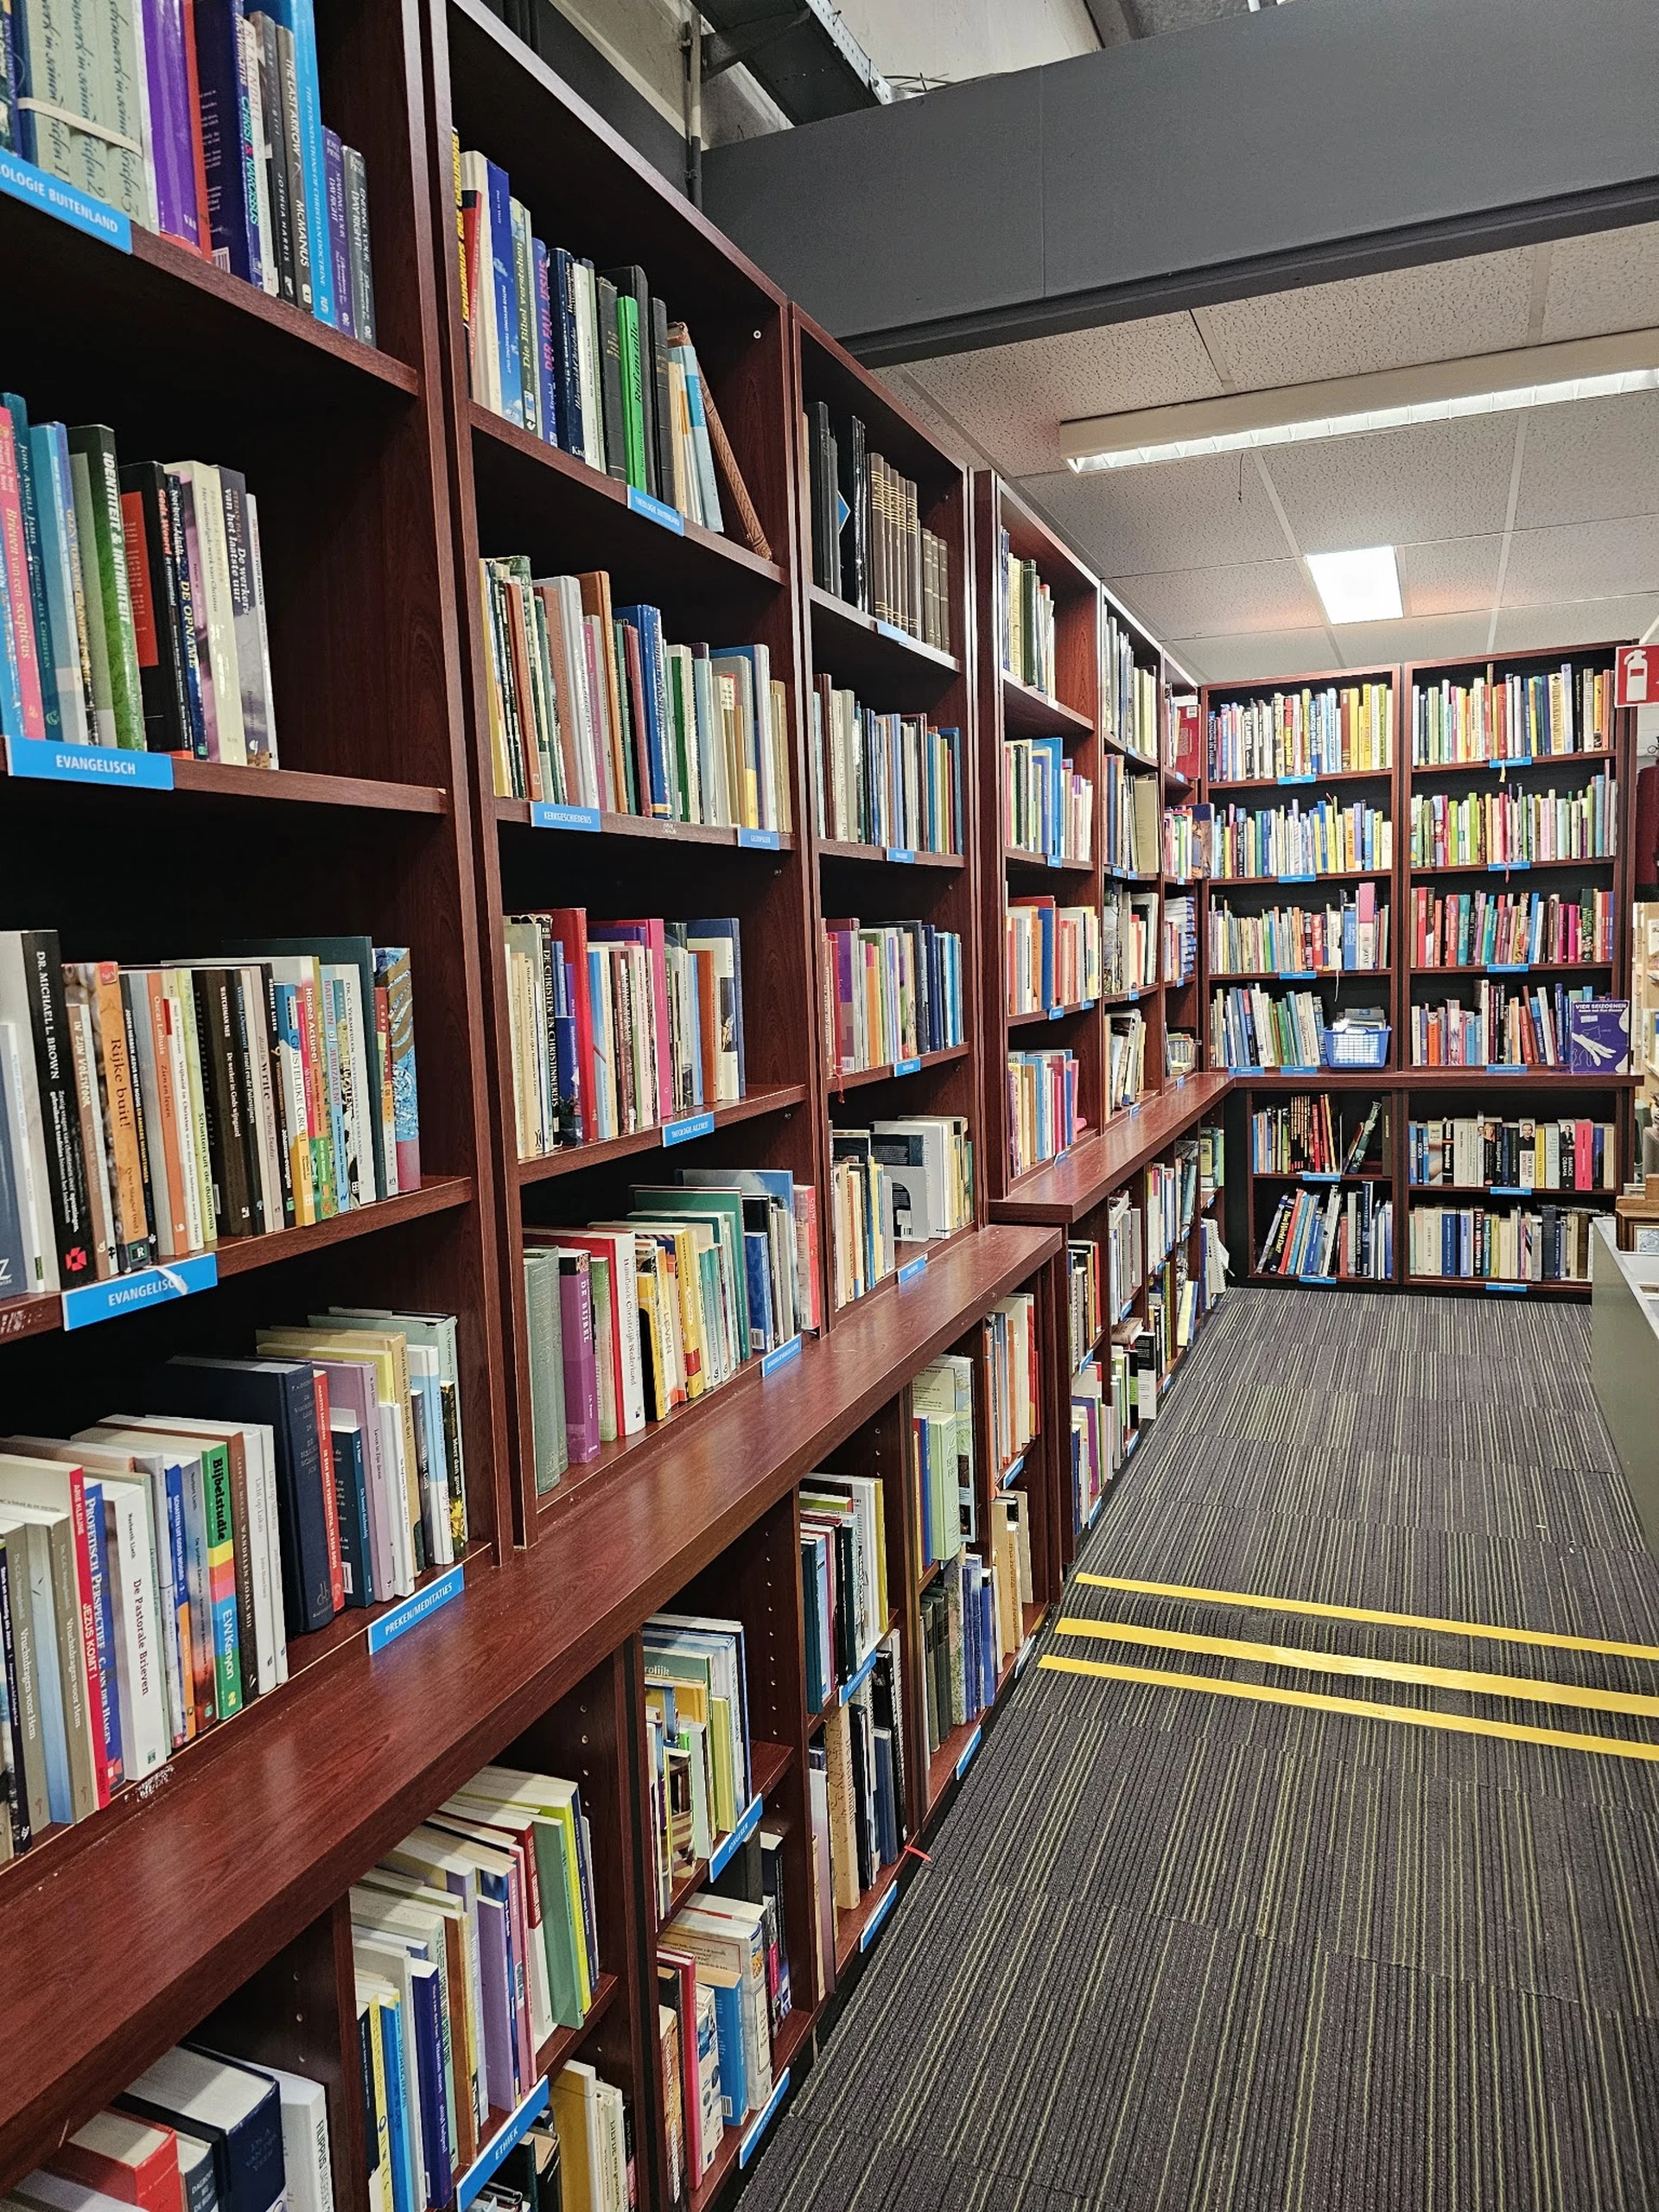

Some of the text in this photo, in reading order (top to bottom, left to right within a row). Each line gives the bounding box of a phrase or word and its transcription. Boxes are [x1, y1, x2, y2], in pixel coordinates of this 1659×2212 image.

[235, 13, 250, 86] McWilliams
[284, 59, 302, 157] THE LAST ARROW
[240, 96, 259, 226] CHRIST & NARCISSUS
[1, 162, 119, 234] OLOGIE BUITENLAND
[277, 172, 290, 263] JOSHUA HARRIS
[350, 189, 363, 248] DAY RIGHT
[514, 242, 531, 370] Die Bibel verstehen
[542, 344, 554, 372] DER
[156, 489, 173, 555] Gods Woord
[170, 489, 181, 524] Norbert
[19, 443, 52, 670] JOHN ANGELL JAMES GROEIEN ALS CHRISTEN
[102, 451, 130, 624] IDENTITEIT & INTIMITEIT
[224, 487, 243, 603] van het laatste uur
[4, 507, 32, 659] Brieven van een scepticus
[237, 548, 251, 615] De werkers
[181, 581, 197, 669] DE OPNAME
[56, 754, 137, 776] EVANGELISCH
[35, 950, 48, 970] DR.
[38, 972, 55, 1025] MICHAEL
[219, 986, 229, 1025] WATCHMAN
[73, 1020, 83, 1033] IN
[73, 1034, 86, 1056] ZIJN
[126, 1029, 136, 1053] HEBBEN
[305, 988, 319, 1064] Hosea Actueel
[323, 979, 340, 1107] BABYLON of JERUZALEM?
[543, 950, 559, 1108] DE CHRISTEN EN CHRISTINNEREIS
[45, 1036, 60, 1080] BROWN
[109, 1038, 132, 1128] Rijke buit!
[154, 995, 173, 1119] Oscar Lohuis leven
[226, 1059, 235, 1083] werker
[56, 1090, 67, 1109] Zestig
[133, 1088, 142, 1108] NODIG
[230, 1090, 238, 1107] Gods
[289, 1034, 308, 1142] GEESTELIJKE GROEI
[49, 1091, 60, 1123] gebruiken
[57, 1158, 67, 1179] binnen
[59, 1109, 70, 1130] vragen
[137, 1116, 145, 1141] ANDERE
[230, 1108, 242, 1138] wijngaard
[64, 1144, 75, 1177] christenen
[67, 1178, 76, 1192] over
[198, 1112, 207, 1153] Schatten
[204, 1185, 215, 1230] duisternis
[68, 1192, 80, 1233] opvattingen,
[108, 1275, 183, 1307] EVANGELISC
[580, 1281, 589, 1343] DE BIJBEL
[623, 1257, 638, 1386] Handboek Christelijk Nederland
[451, 1438, 461, 1459] Meer
[421, 1471, 430, 1490] God
[453, 1474, 463, 1496] goud
[85, 1496, 99, 1573] PROFETISCH
[173, 1494, 181, 1527] SCHATTEN
[175, 1538, 183, 1555] GODS
[176, 1555, 186, 1581] WOORD
[211, 1457, 227, 1541] Bijbelstudie
[221, 1636, 237, 1681] Kenyon
[73, 1484, 98, 1673] ARIE JEZUS KOMT
[240, 1524, 253, 1628] WANDELEN ZOALS HIJ
[88, 1572, 107, 1649] PERSPECTIEF
[385, 1583, 454, 1637] PREKEN/MEDITATIES
[132, 1579, 151, 1696] De Pastorale Brieven
[18, 1627, 38, 1740] Vruchtdragen voor Hem
[65, 1618, 83, 1728] Vruchtdragen voor Hem
[101, 1707, 112, 1745] HAAGEN
[728, 1824, 749, 1854] JONGEREN
[435, 2039, 443, 2073] Waarom
[316, 2119, 328, 2170] FILIPPUS
[495, 2125, 519, 2160] ETHIEK
